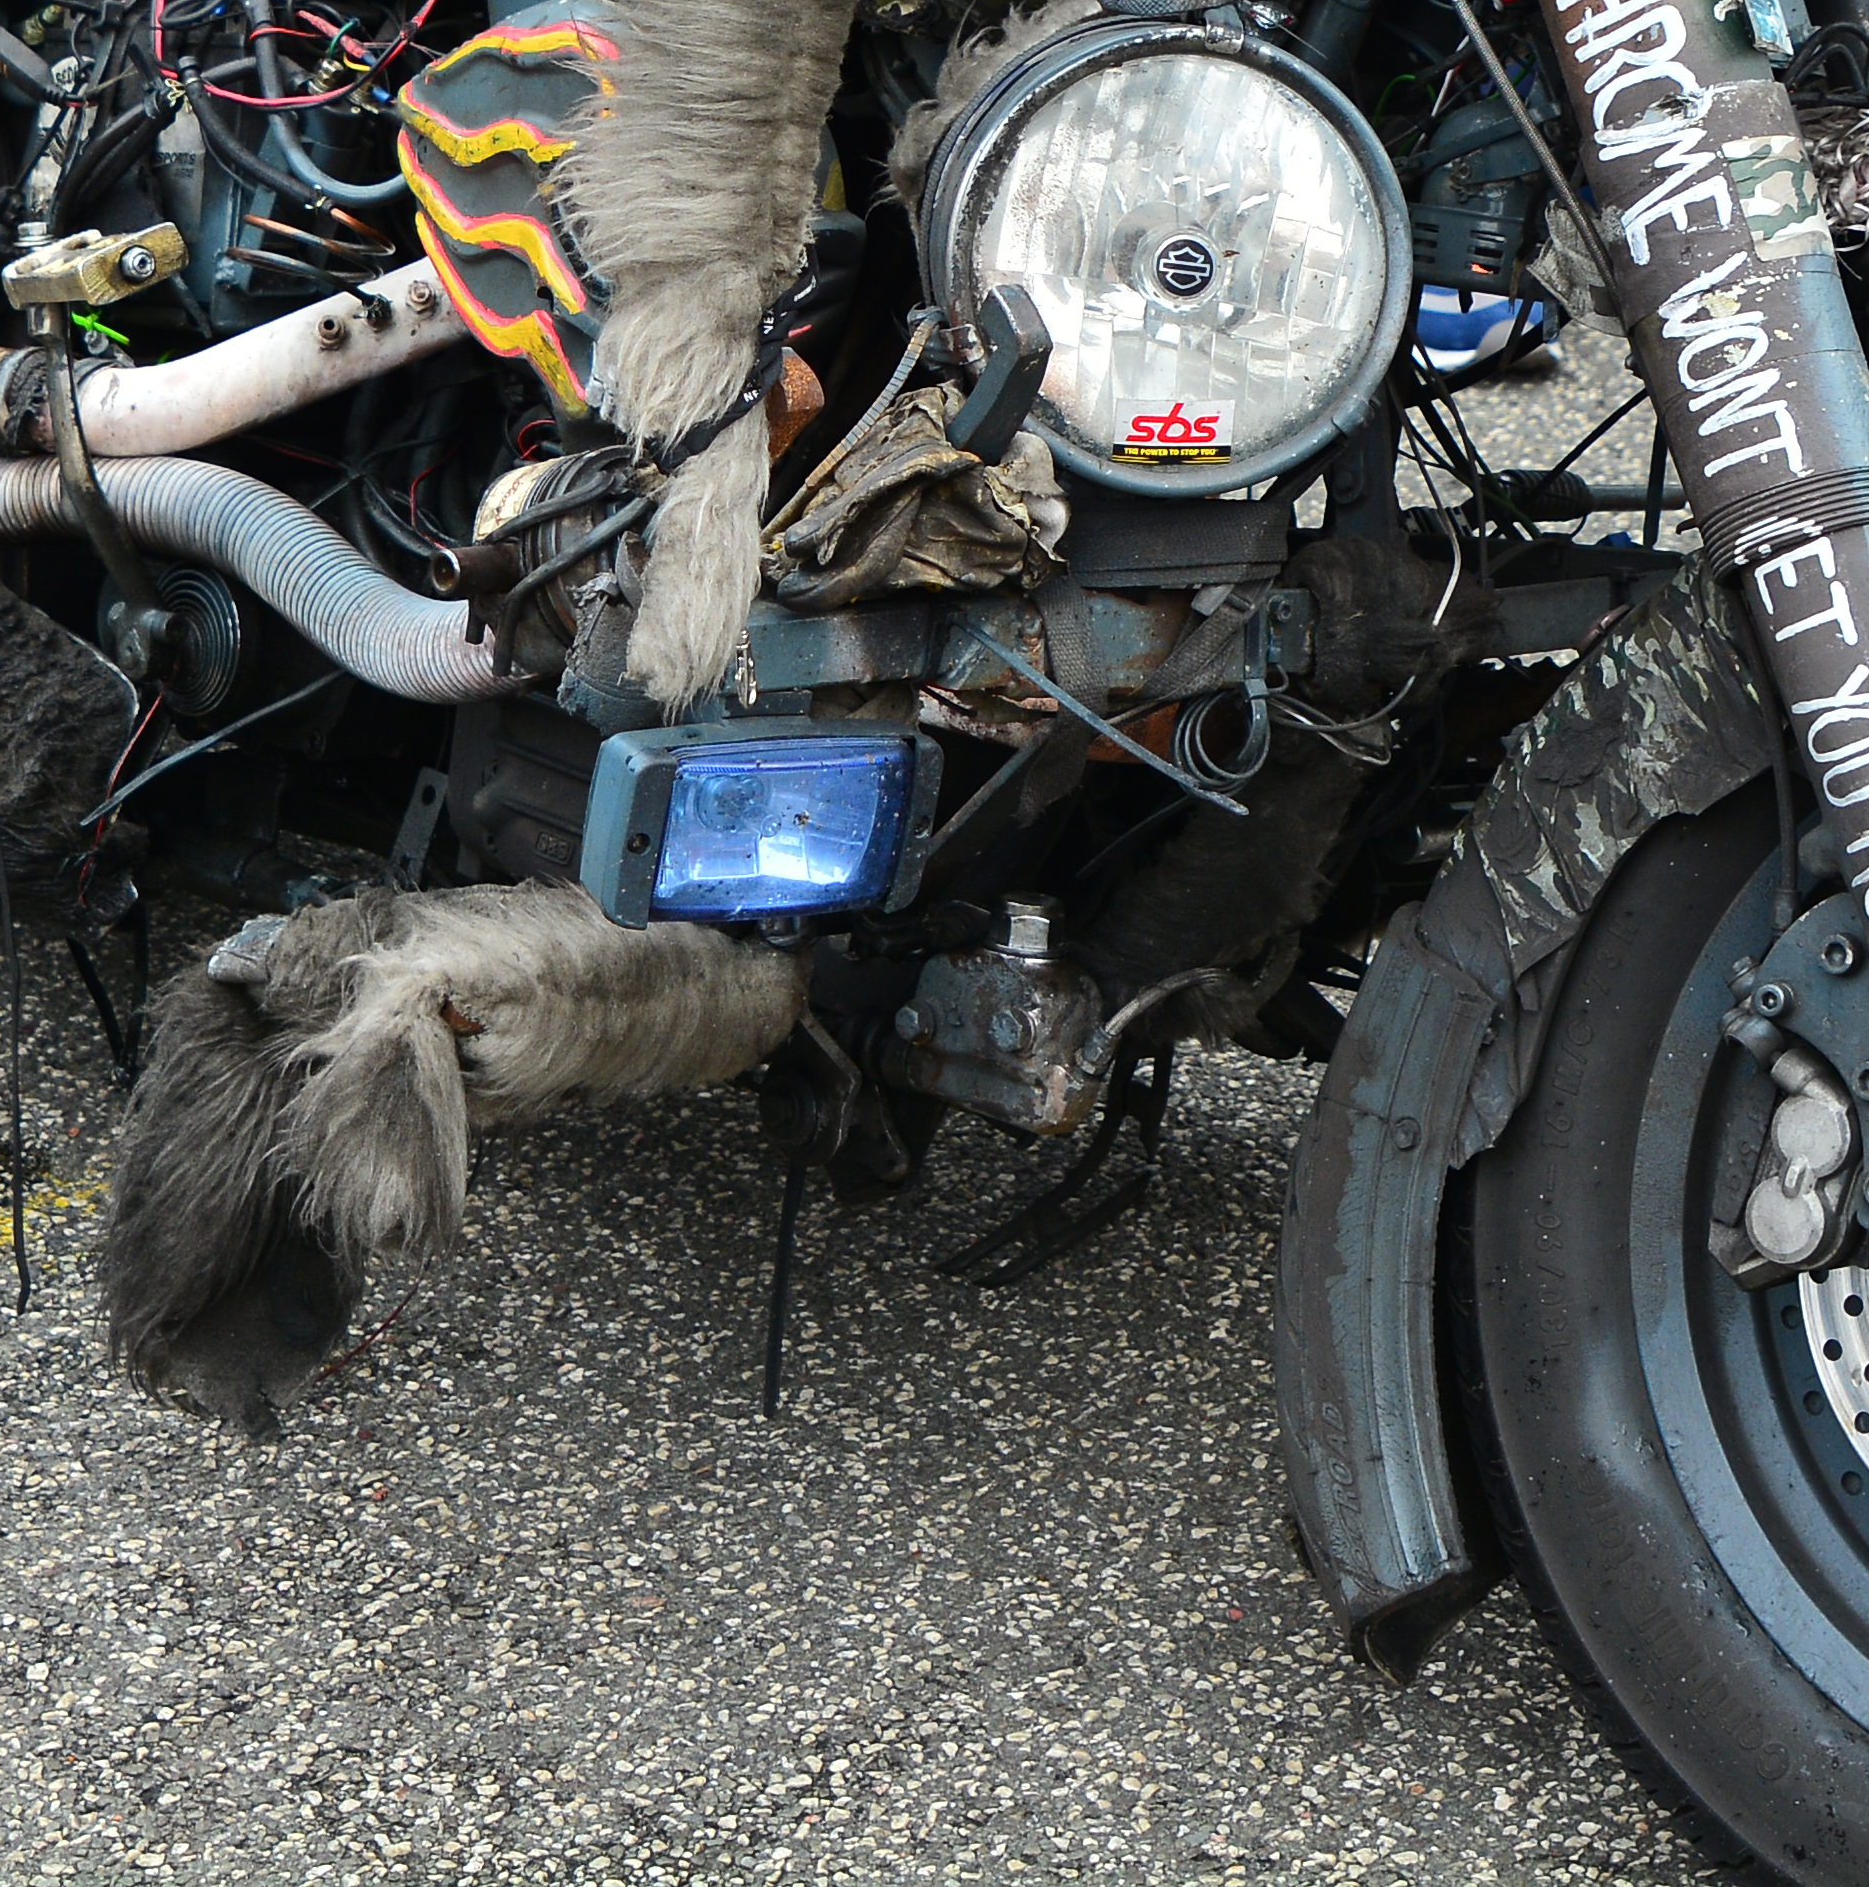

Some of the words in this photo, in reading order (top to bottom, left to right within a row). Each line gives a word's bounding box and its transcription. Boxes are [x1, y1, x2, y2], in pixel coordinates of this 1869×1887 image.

[1658, 250, 1805, 478] WONT
[1125, 402, 1221, 444] sbs
[1140, 448, 1169, 456] POWER
[1168, 448, 1180, 456] TO
[1200, 448, 1217, 456] YOU
